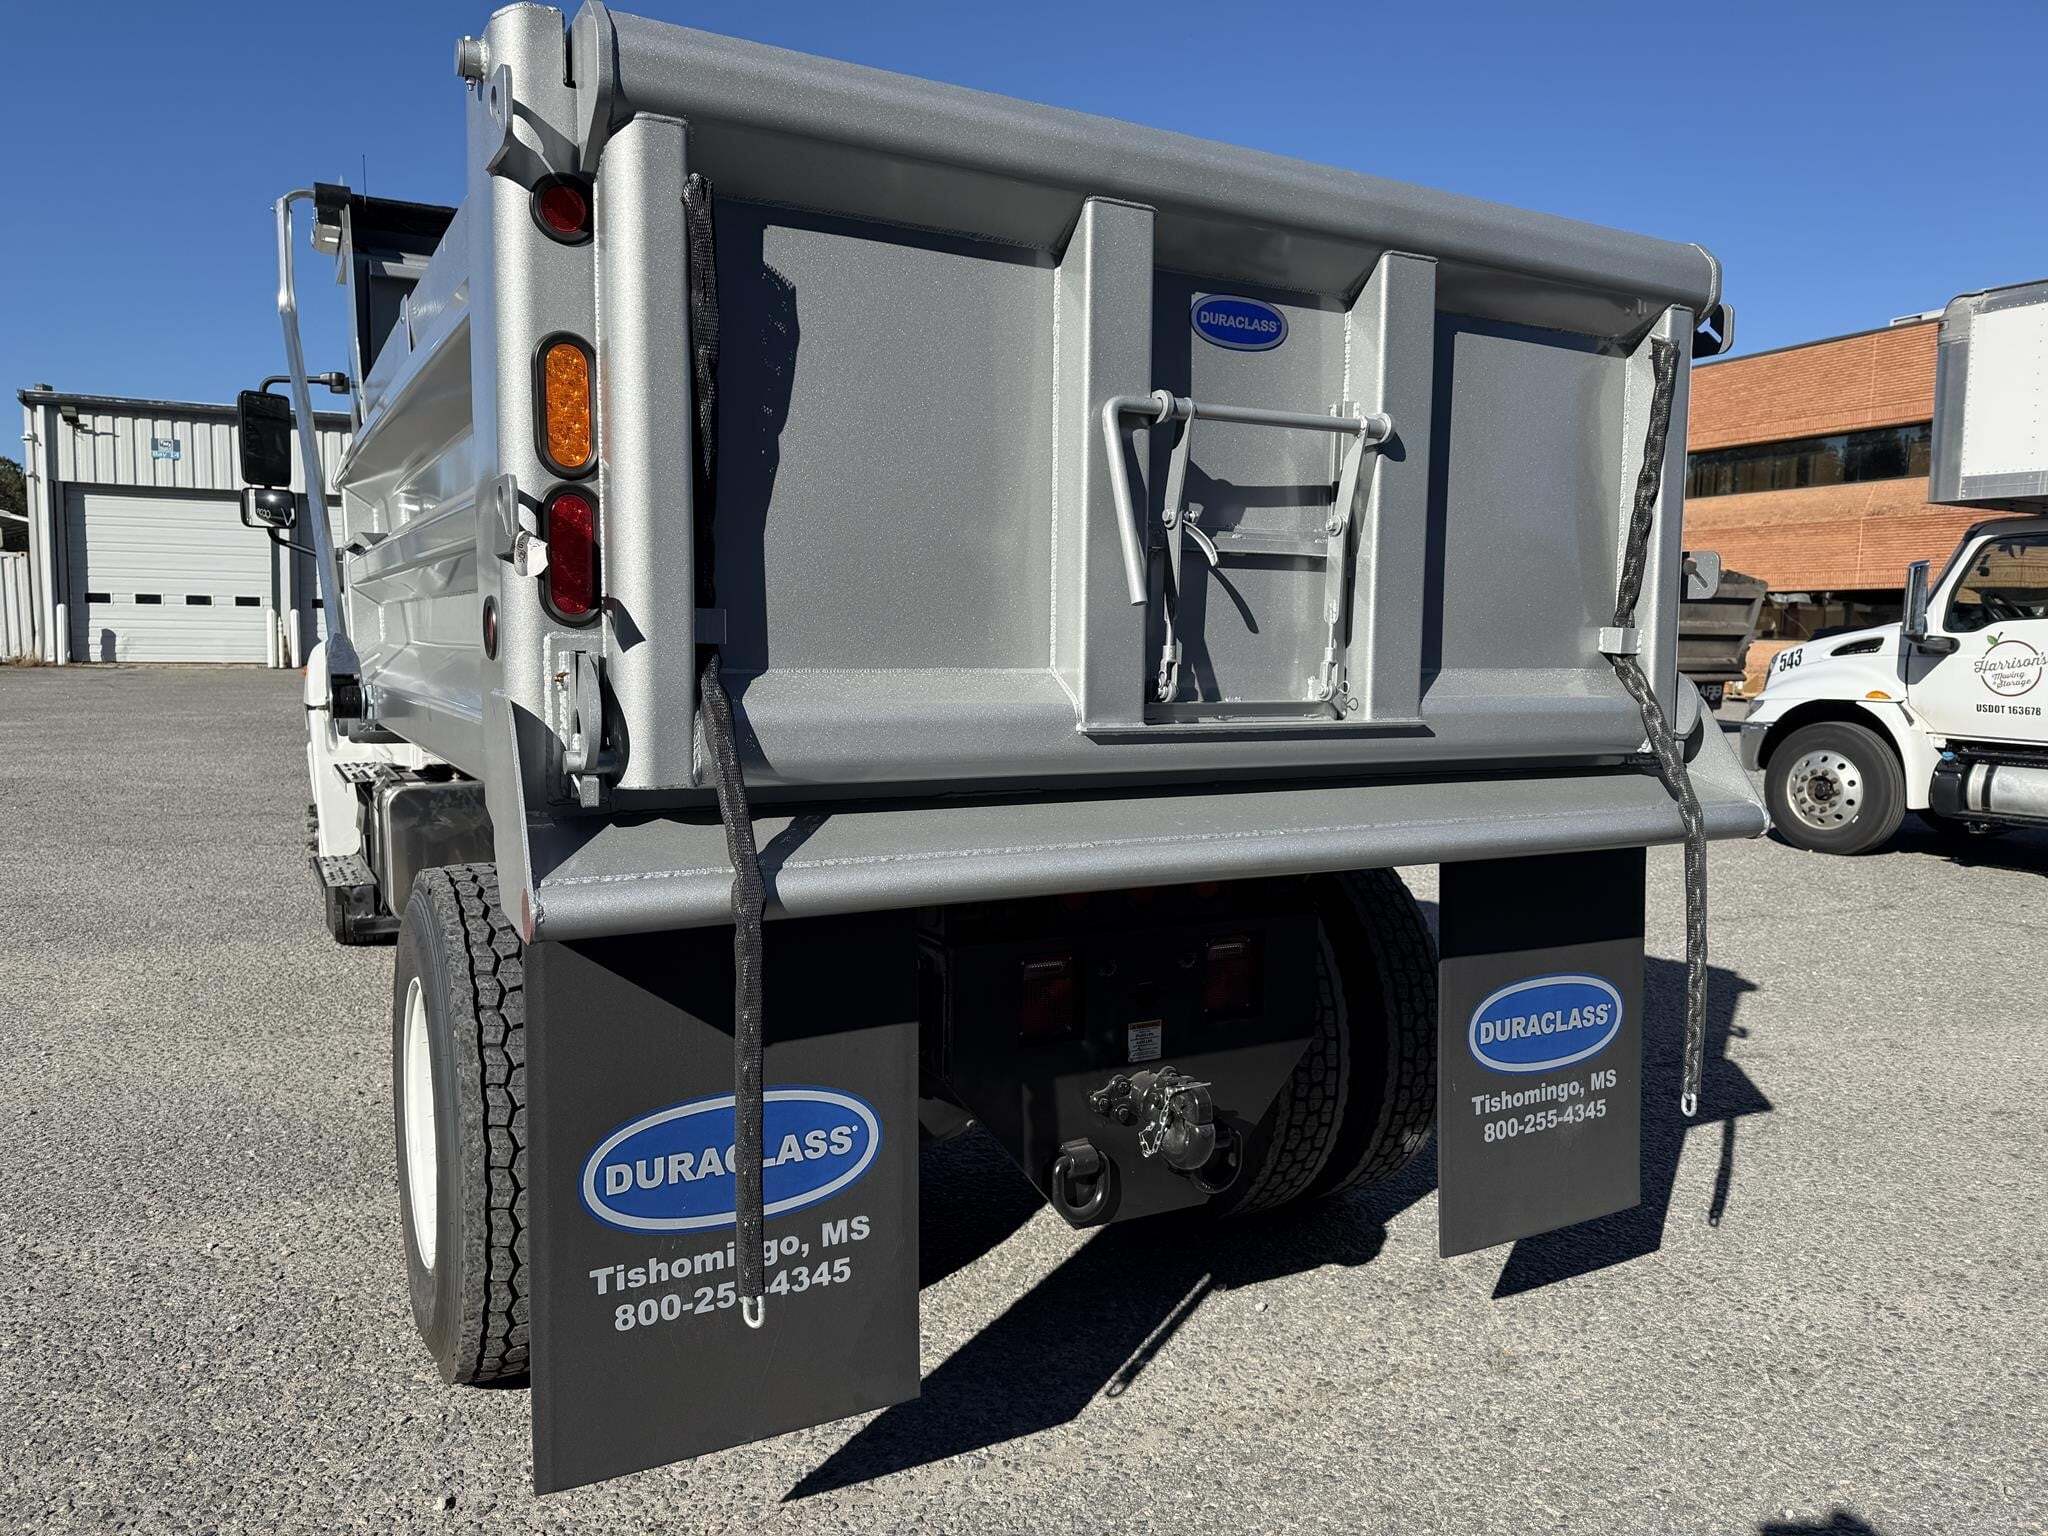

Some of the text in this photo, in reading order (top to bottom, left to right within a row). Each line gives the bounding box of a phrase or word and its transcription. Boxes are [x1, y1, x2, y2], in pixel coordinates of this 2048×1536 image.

[1200, 311, 1277, 333] DURACLASS
[1780, 648, 1803, 672] 543
[1974, 652, 2048, 673] Harrison's
[1992, 671, 2025, 682] Moving
[1976, 704, 2042, 716] USDOT 163678
[1480, 1003, 1610, 1045] DURACLASS
[1471, 1069, 1617, 1116] Tishomingo, MS
[1483, 1098, 1607, 1143] 800-255-4345
[589, 1215, 871, 1296] Tishomigo, MS
[614, 1257, 852, 1332] 800-254345
